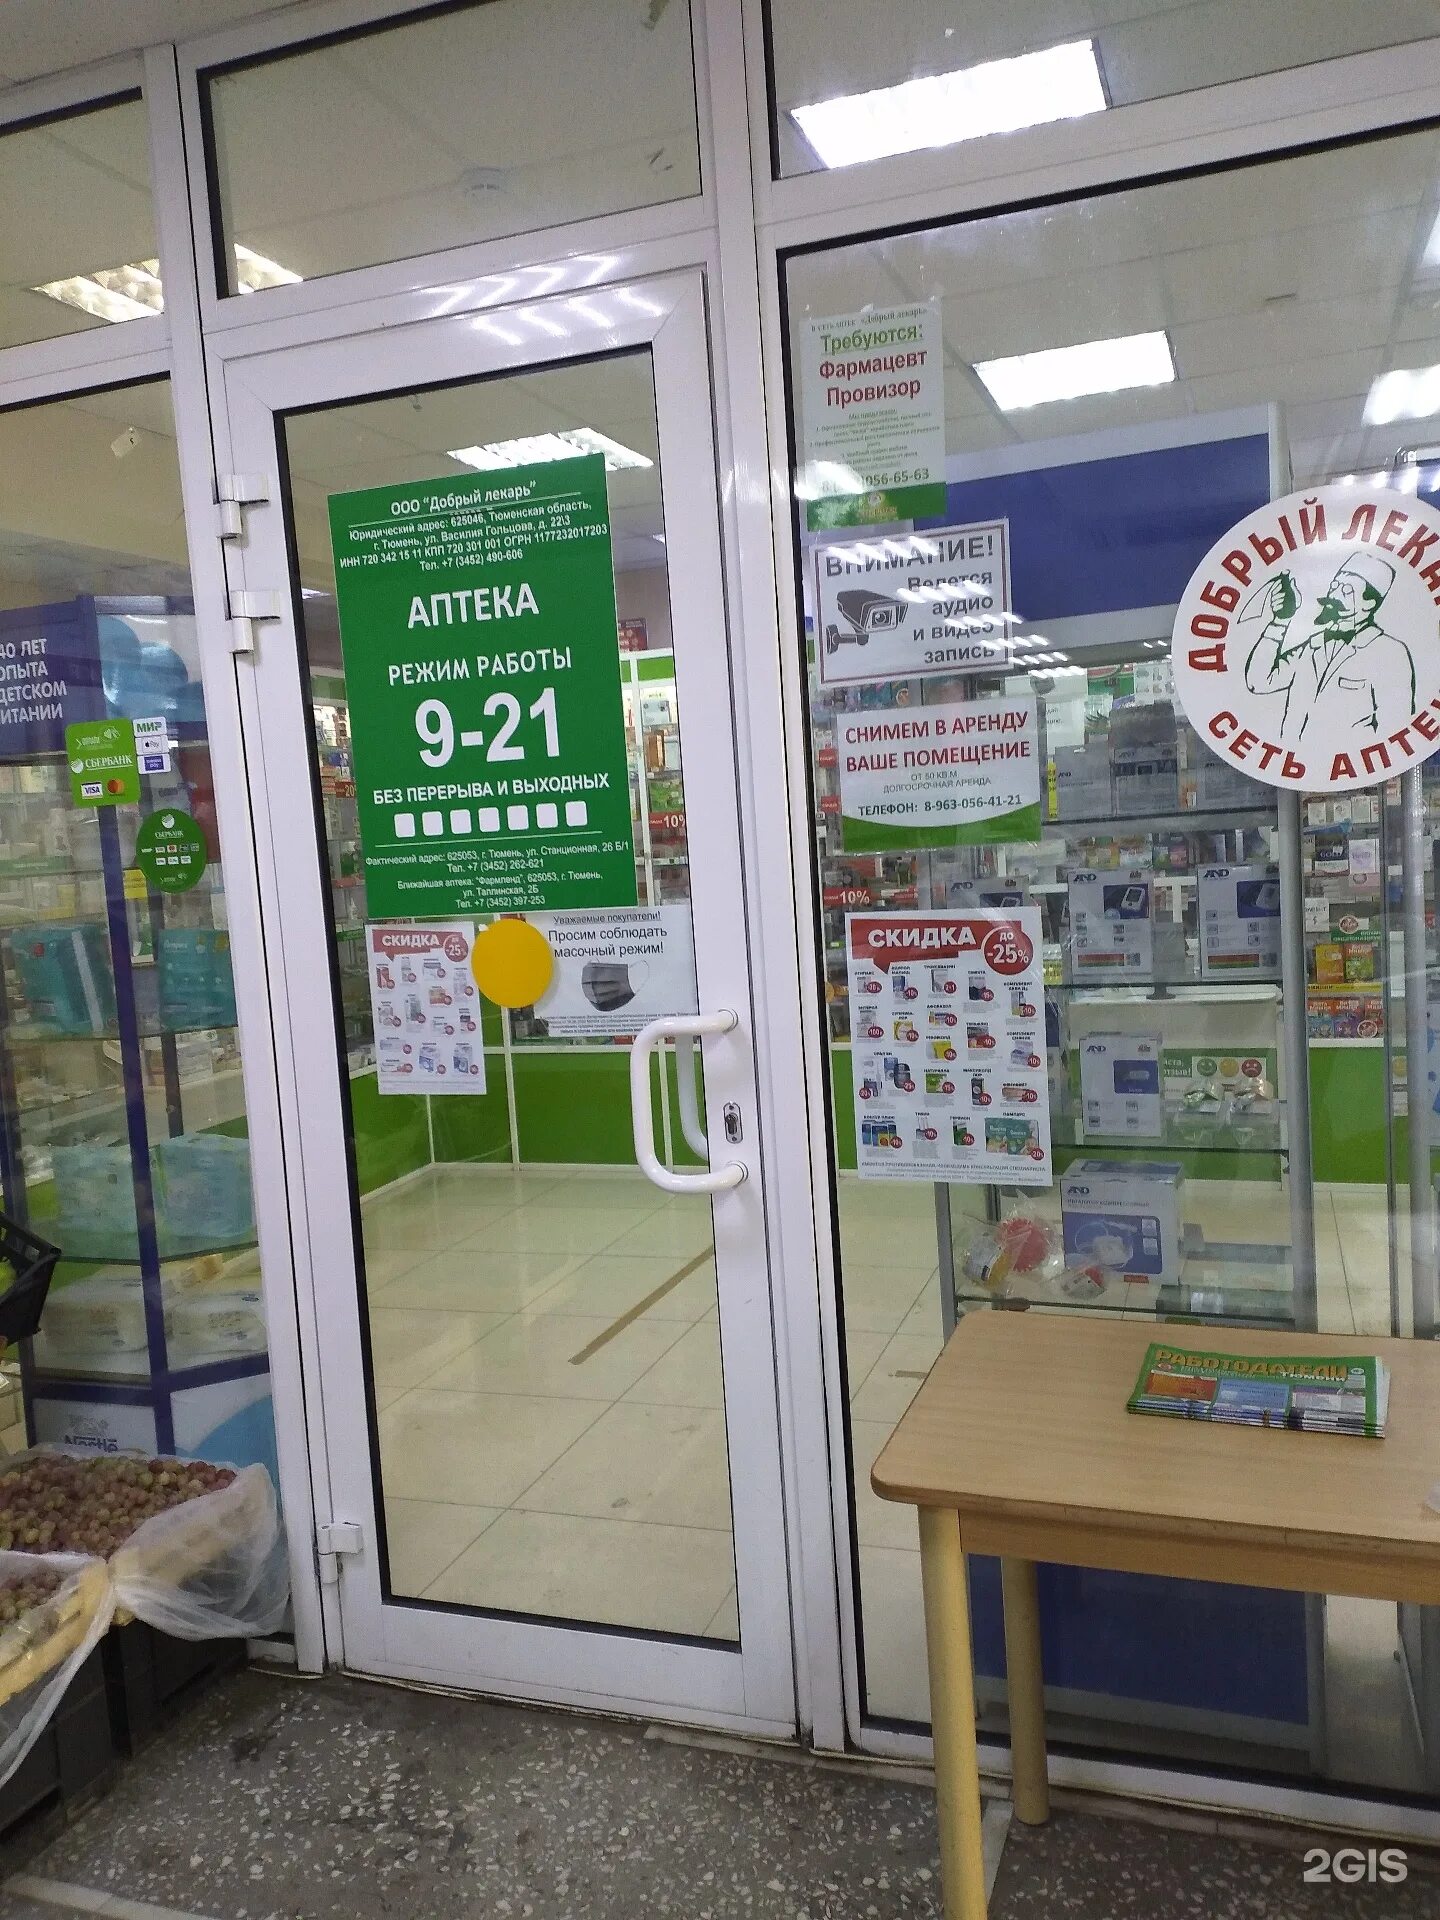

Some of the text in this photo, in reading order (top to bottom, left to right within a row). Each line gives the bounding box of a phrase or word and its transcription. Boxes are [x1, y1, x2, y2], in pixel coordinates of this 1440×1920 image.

[820, 323, 924, 356] Требуются:
[819, 350, 928, 381] Фармацевт
[827, 379, 921, 409] Провизор
[390, 499, 420, 516] ООО
[349, 500, 592, 541] Юридический адрес: 625046, Тюменская область,
[340, 523, 608, 569] ИНН 720 342 15 11 КПП 720 301 001 ОГРН 1177232017203
[382, 538, 423, 550] Тюмень,
[424, 534, 440, 546] ул.
[441, 529, 484, 543] Василия
[486, 521, 536, 538] Гольцова,
[538, 520, 548, 531] д.
[419, 548, 523, 572] Тел. +7 (3452) 490-606
[825, 534, 994, 578] ВНИМАНИЕ!
[1188, 496, 1329, 674] ДОБРЫЙ
[406, 582, 540, 629] АПТЕКА
[932, 596, 994, 618] аудио
[913, 621, 995, 641] и видео
[20, 638, 48, 657] ЛЕТ
[924, 645, 996, 664] запись
[388, 646, 572, 687] РЕЖИМ РАБОТЫ
[0, 702, 63, 725] ИТАНИИ
[136, 721, 162, 733] МИР
[415, 687, 560, 768] 9-21
[845, 711, 1029, 745] СНИМЕМ В АРЕНДУ
[846, 740, 1031, 773] ВАШЕ ПОМЕЩЕНИЕ
[1208, 710, 1307, 781] СЕТЬ
[85, 754, 133, 769] СБЕРБАНК
[373, 772, 610, 806] БЕЗ ПЕРЕРЫВА И ВЫХОДНЫХ
[883, 776, 992, 795] ДОЛГОСРОЧНАЯ АРЕНДА
[910, 773, 923, 782] ОТ
[84, 786, 101, 795] VISA
[857, 793, 1022, 817] ТЕЛЕФОН: 8-963-056-41-21
[365, 854, 418, 867] Фактический
[418, 853, 446, 866] адрес:
[488, 848, 525, 859] Тюмень,
[525, 849, 539, 858] ул.
[540, 844, 601, 857] Станционная,
[446, 858, 544, 873] Тел. +7 (3452) 262-621
[397, 879, 444, 890] Ближайшая
[455, 895, 545, 909] Тел. +7 (3452) 397-253
[839, 888, 871, 905] 10%
[553, 910, 662, 925] Уважаемые покупатели!
[381, 934, 441, 948] СКИДКА
[549, 926, 668, 944] Просим соблюдать
[867, 926, 977, 950] СКИДКА
[999, 931, 1014, 942] ДО
[554, 941, 664, 958] масочный режим!
